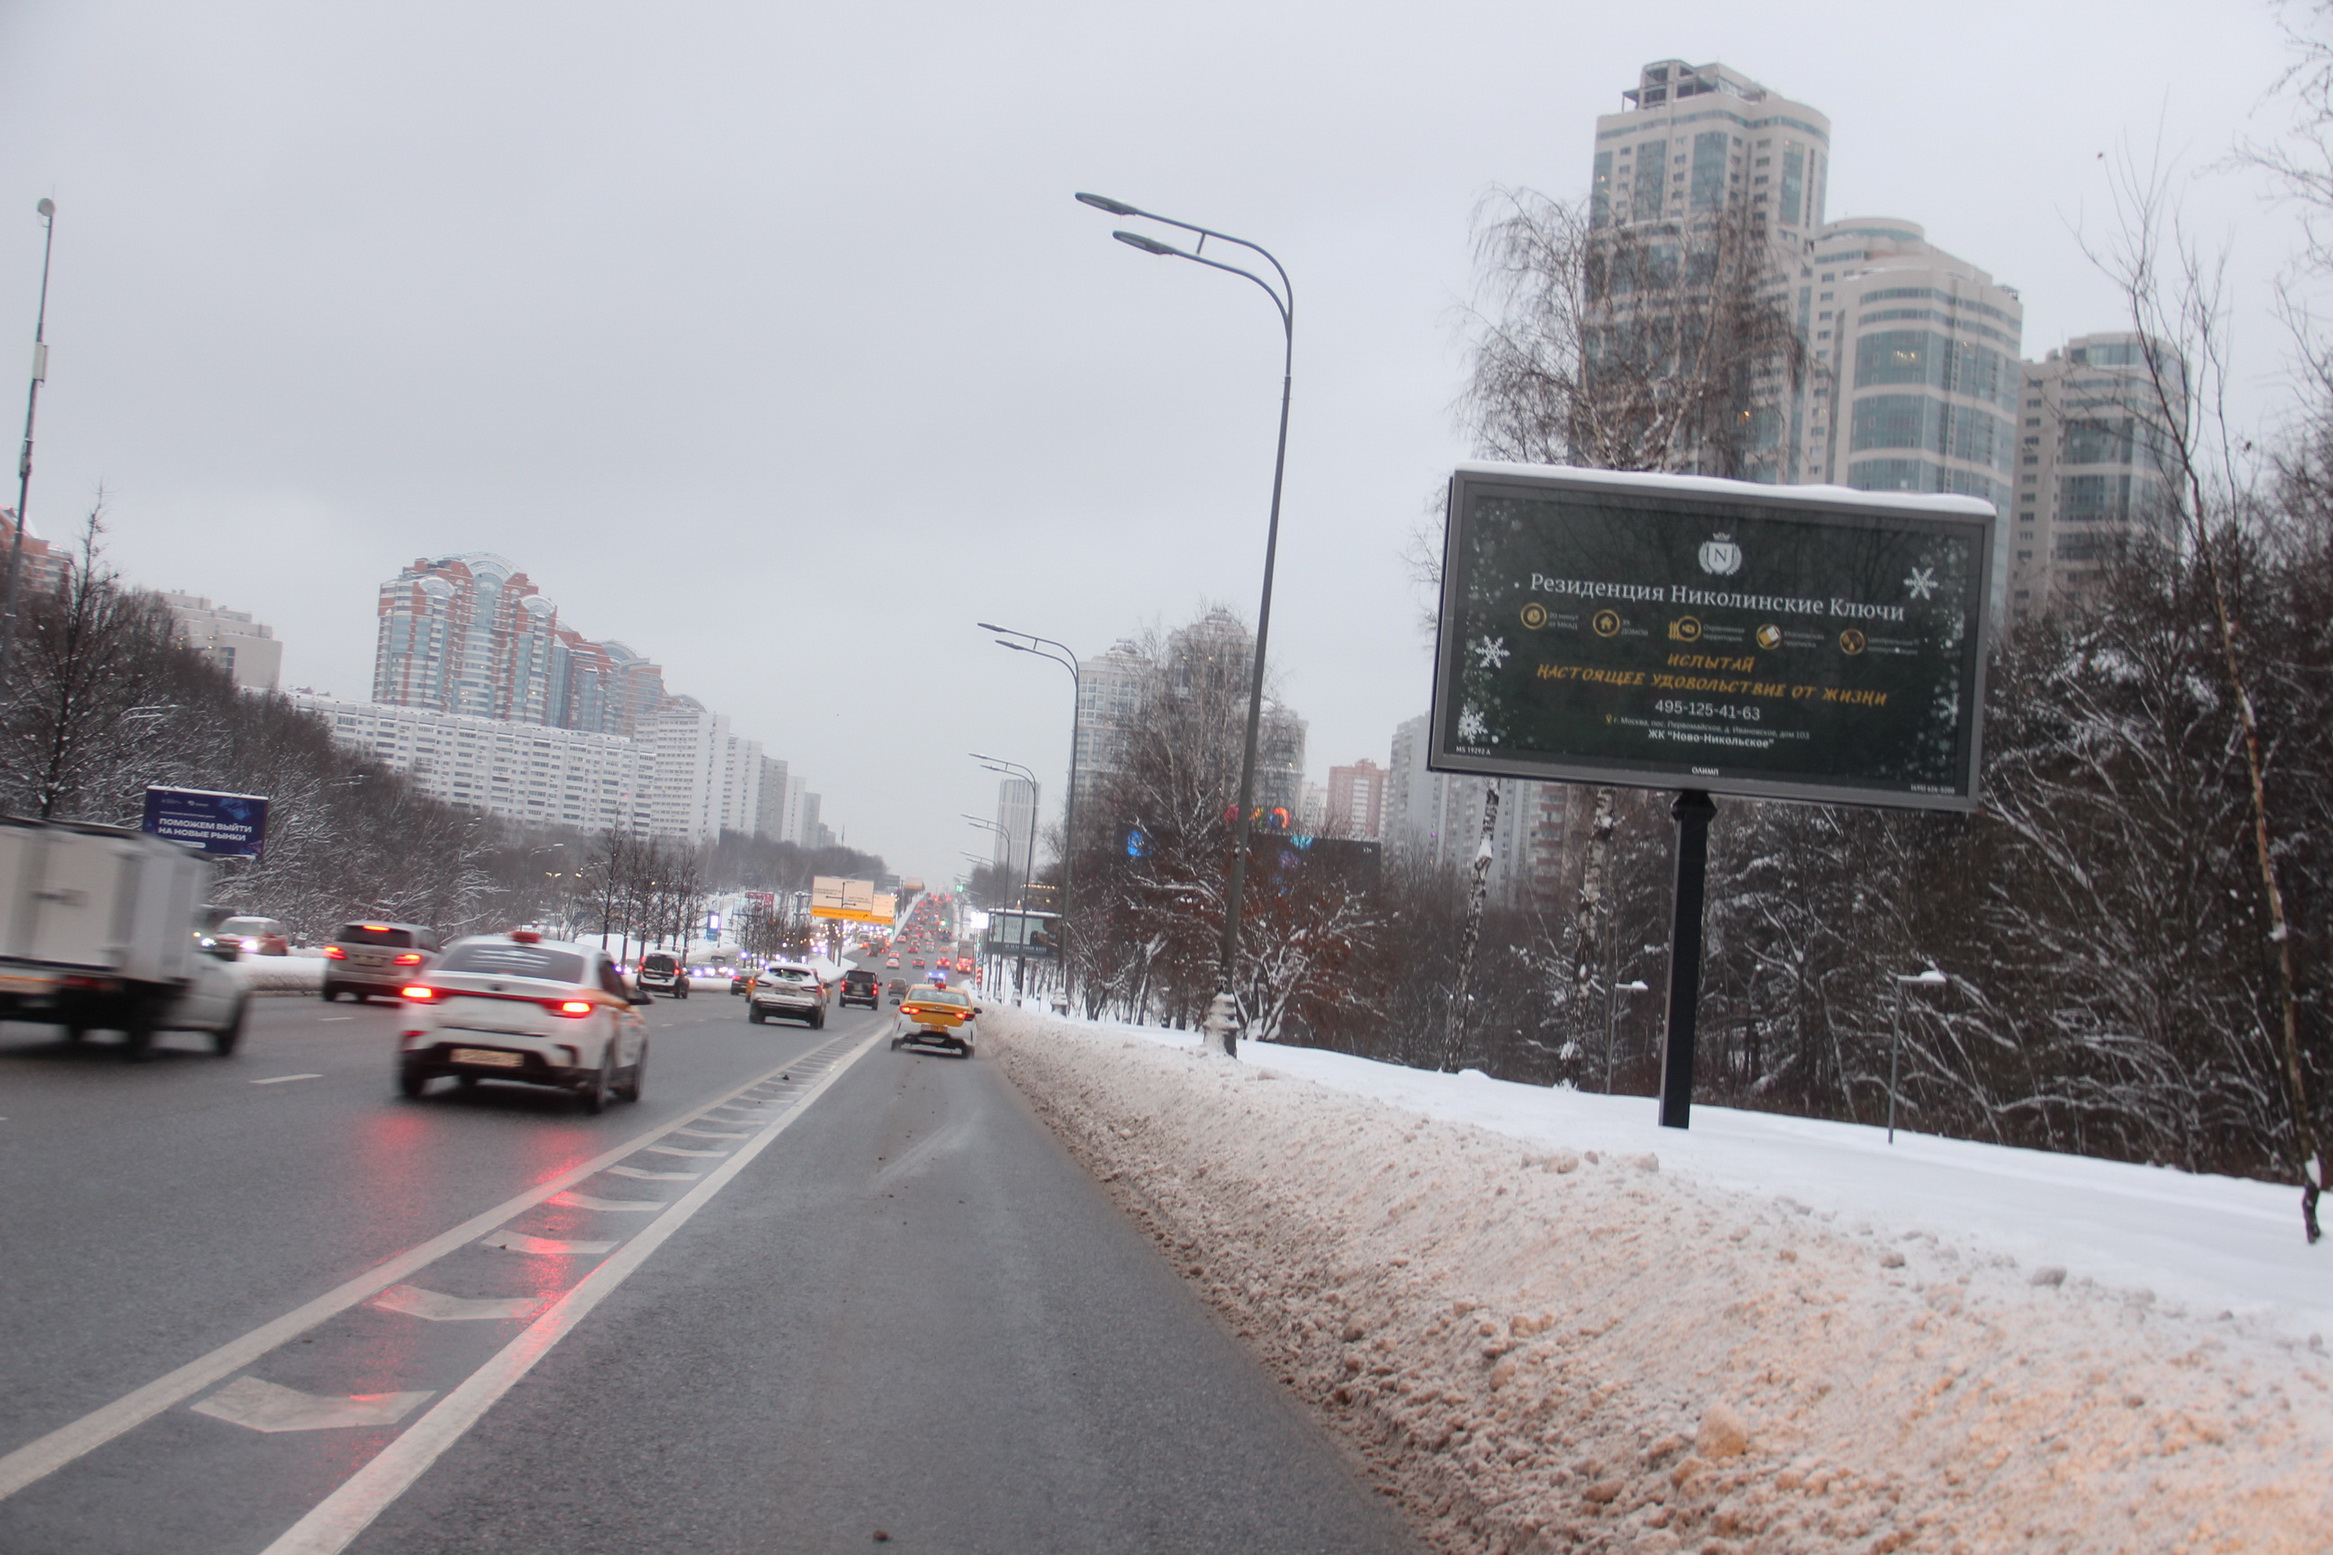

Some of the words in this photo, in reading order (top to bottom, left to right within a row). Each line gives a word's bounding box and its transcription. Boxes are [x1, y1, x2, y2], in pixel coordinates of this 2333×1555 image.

[1714, 548, 1727, 563] N
[1530, 572, 1664, 602] Резиденция
[1671, 584, 1824, 615] Николинские
[1829, 598, 1904, 621] Ключи
[1557, 621, 1578, 631] МКАД
[1667, 653, 1756, 673] ИСПЫТАЙ
[1537, 664, 1646, 687] НАСТОЯЩЕЕ
[1650, 673, 1787, 698] УДОВОЛЬСТВИЕ
[1791, 685, 1816, 699] ОТ
[1822, 688, 1888, 707] ЖИЗНИ
[1655, 699, 1761, 721] 495-125-41-63
[1621, 717, 1649, 728] Москва,
[1667, 720, 1723, 734] Первомайское,
[1779, 730, 1795, 740] дом
[1648, 728, 1665, 740] ЖК
[1667, 730, 1775, 749] "Ново-Никольское"
[1691, 766, 1719, 777] ОЛИМП
[158, 827, 173, 835] НА
[174, 829, 209, 839] НОВЫЕ
[210, 832, 247, 842] РЫНКИ
[159, 818, 215, 830] ПОМОЖЕМ
[216, 822, 252, 833] ВЫЙТИ
